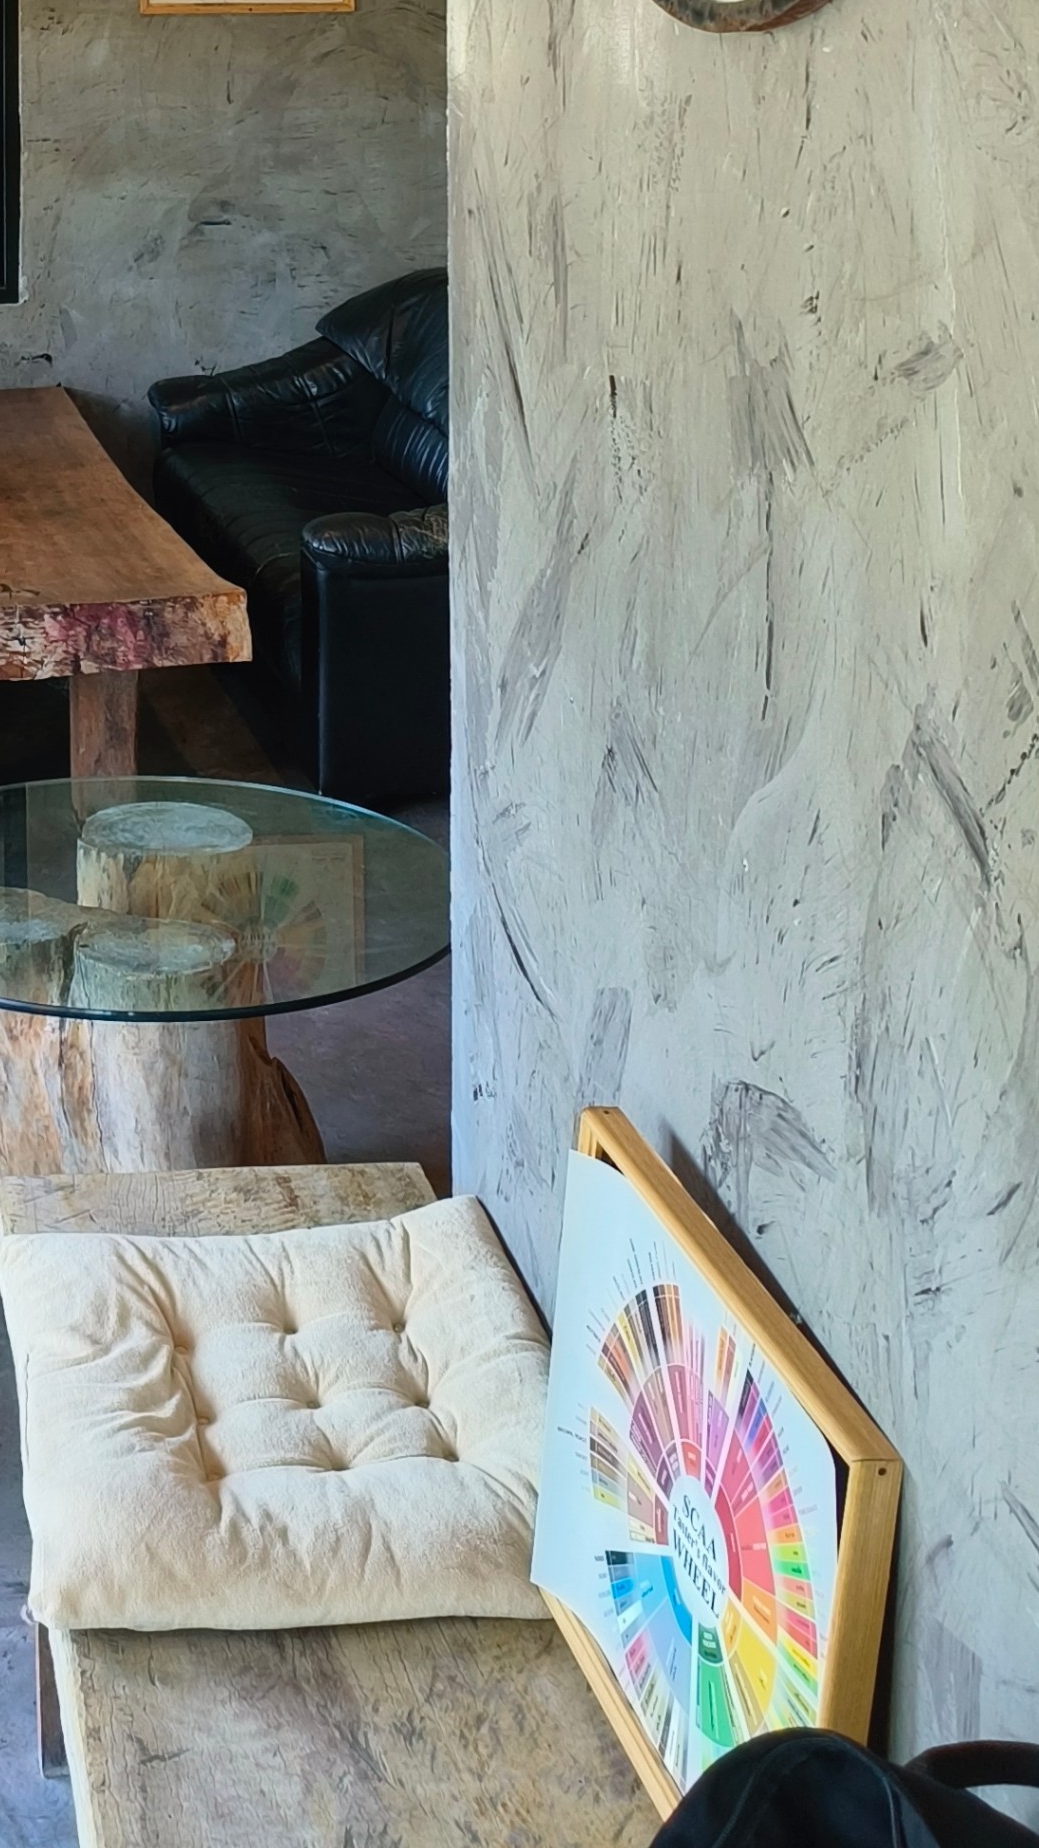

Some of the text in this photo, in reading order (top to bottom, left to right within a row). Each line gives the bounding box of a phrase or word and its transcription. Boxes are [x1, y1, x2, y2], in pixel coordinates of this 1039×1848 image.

[682, 1494, 717, 1562] SCAA
[672, 1527, 720, 1619] WHEEL
[701, 1553, 726, 1595] flavor
